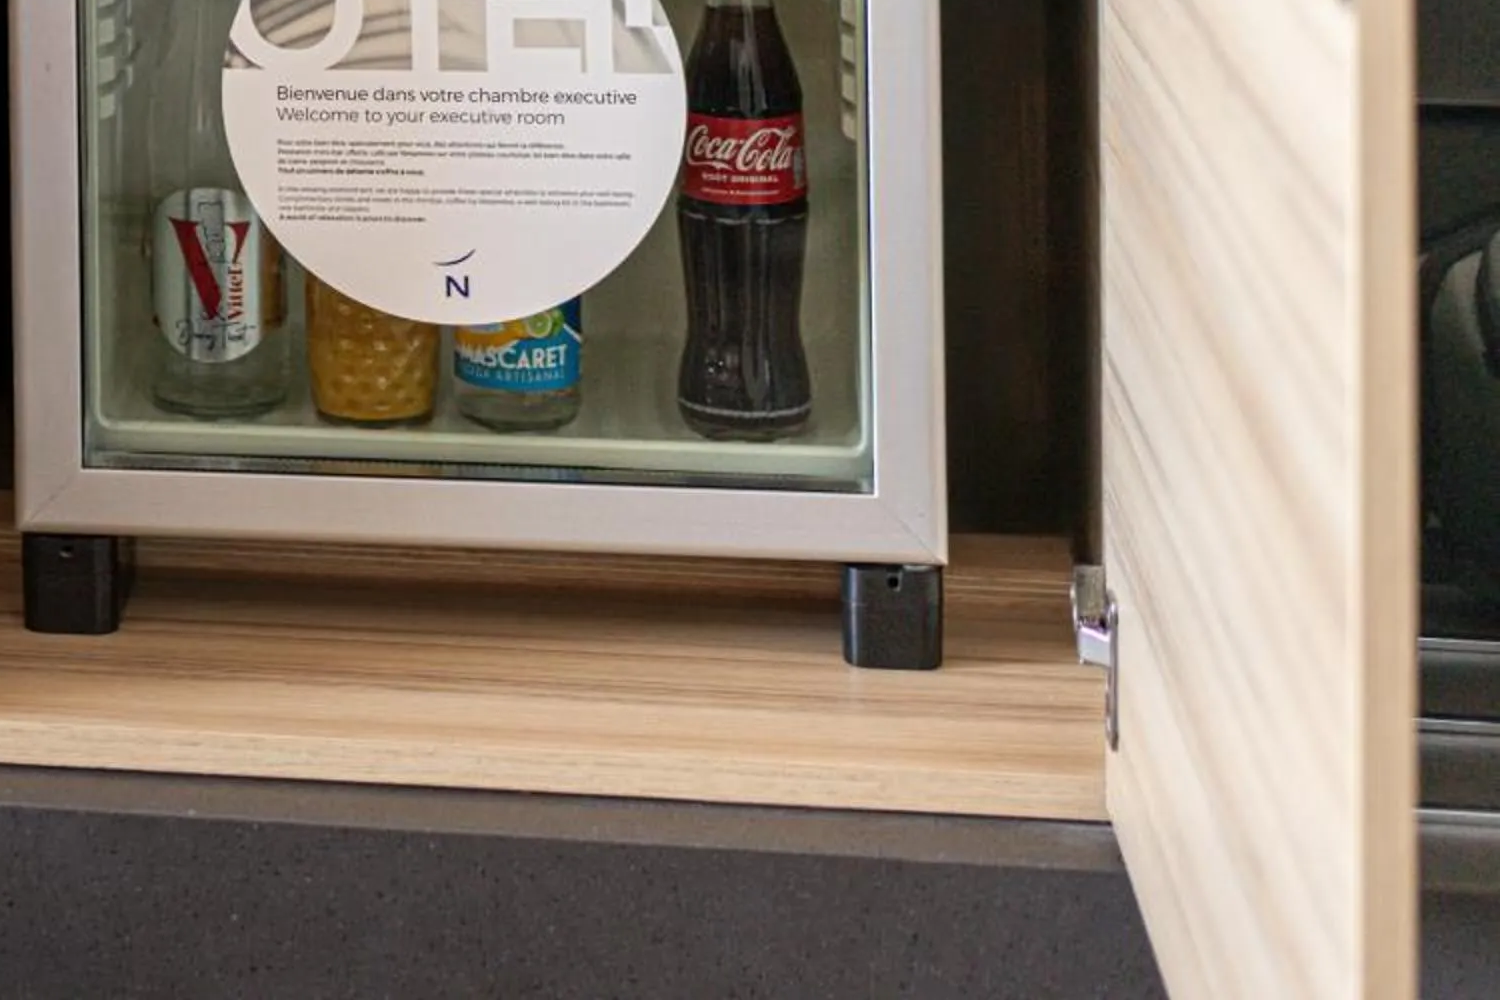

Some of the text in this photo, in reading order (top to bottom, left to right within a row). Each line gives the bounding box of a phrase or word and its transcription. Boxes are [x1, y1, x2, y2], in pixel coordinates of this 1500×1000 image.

[276, 84, 637, 106] Bienvenue dans votre chambre executive
[276, 106, 565, 127] Welcome to your executive room
[686, 123, 797, 173] Coca-Cola
[445, 275, 470, 298] N
